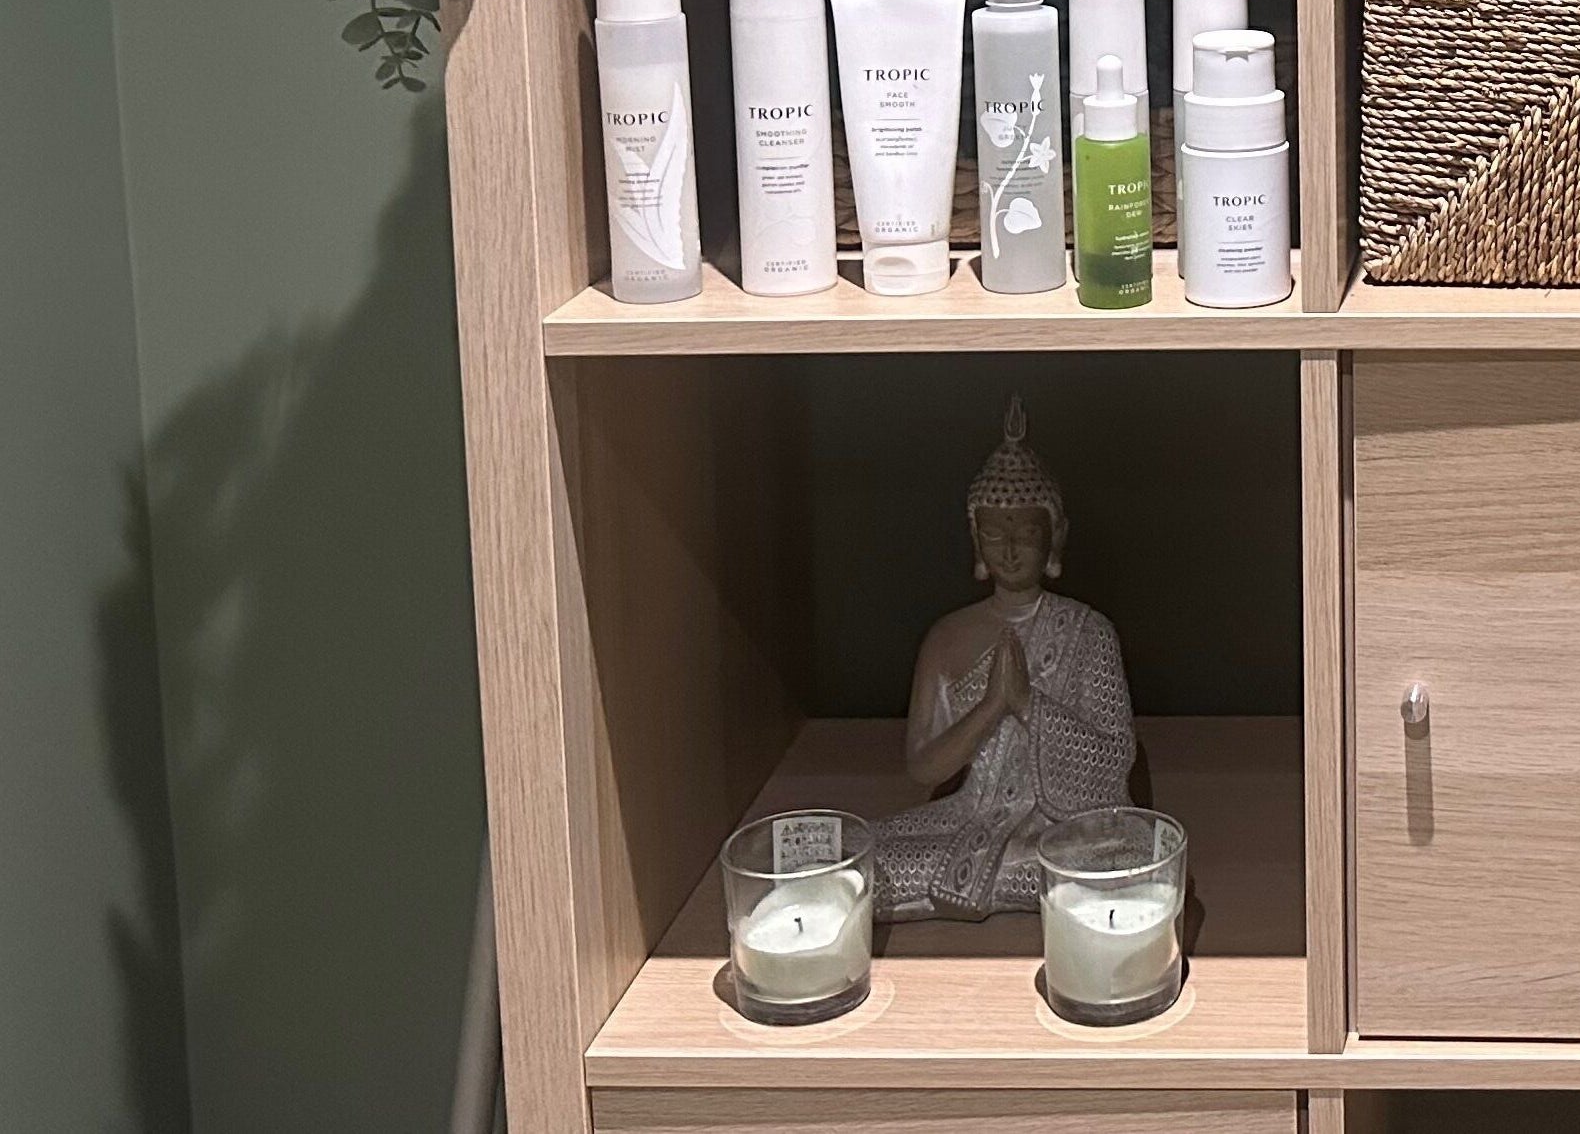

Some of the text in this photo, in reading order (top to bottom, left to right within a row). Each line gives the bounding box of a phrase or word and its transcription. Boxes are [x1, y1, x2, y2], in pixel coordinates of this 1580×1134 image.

[863, 69, 931, 81] TROPIC
[748, 104, 814, 120] TROPIC
[984, 99, 1046, 114] TROPIC
[605, 111, 670, 126] TROPIC
[756, 128, 807, 138] SMOOTHING
[758, 138, 805, 147] CLEANSER
[1108, 180, 1149, 196] TROPI
[1213, 194, 1267, 207] TROPIC
[1226, 215, 1254, 223] CLEAR
[1228, 223, 1253, 231] SKIES
[764, 264, 808, 273] ORGANIC
